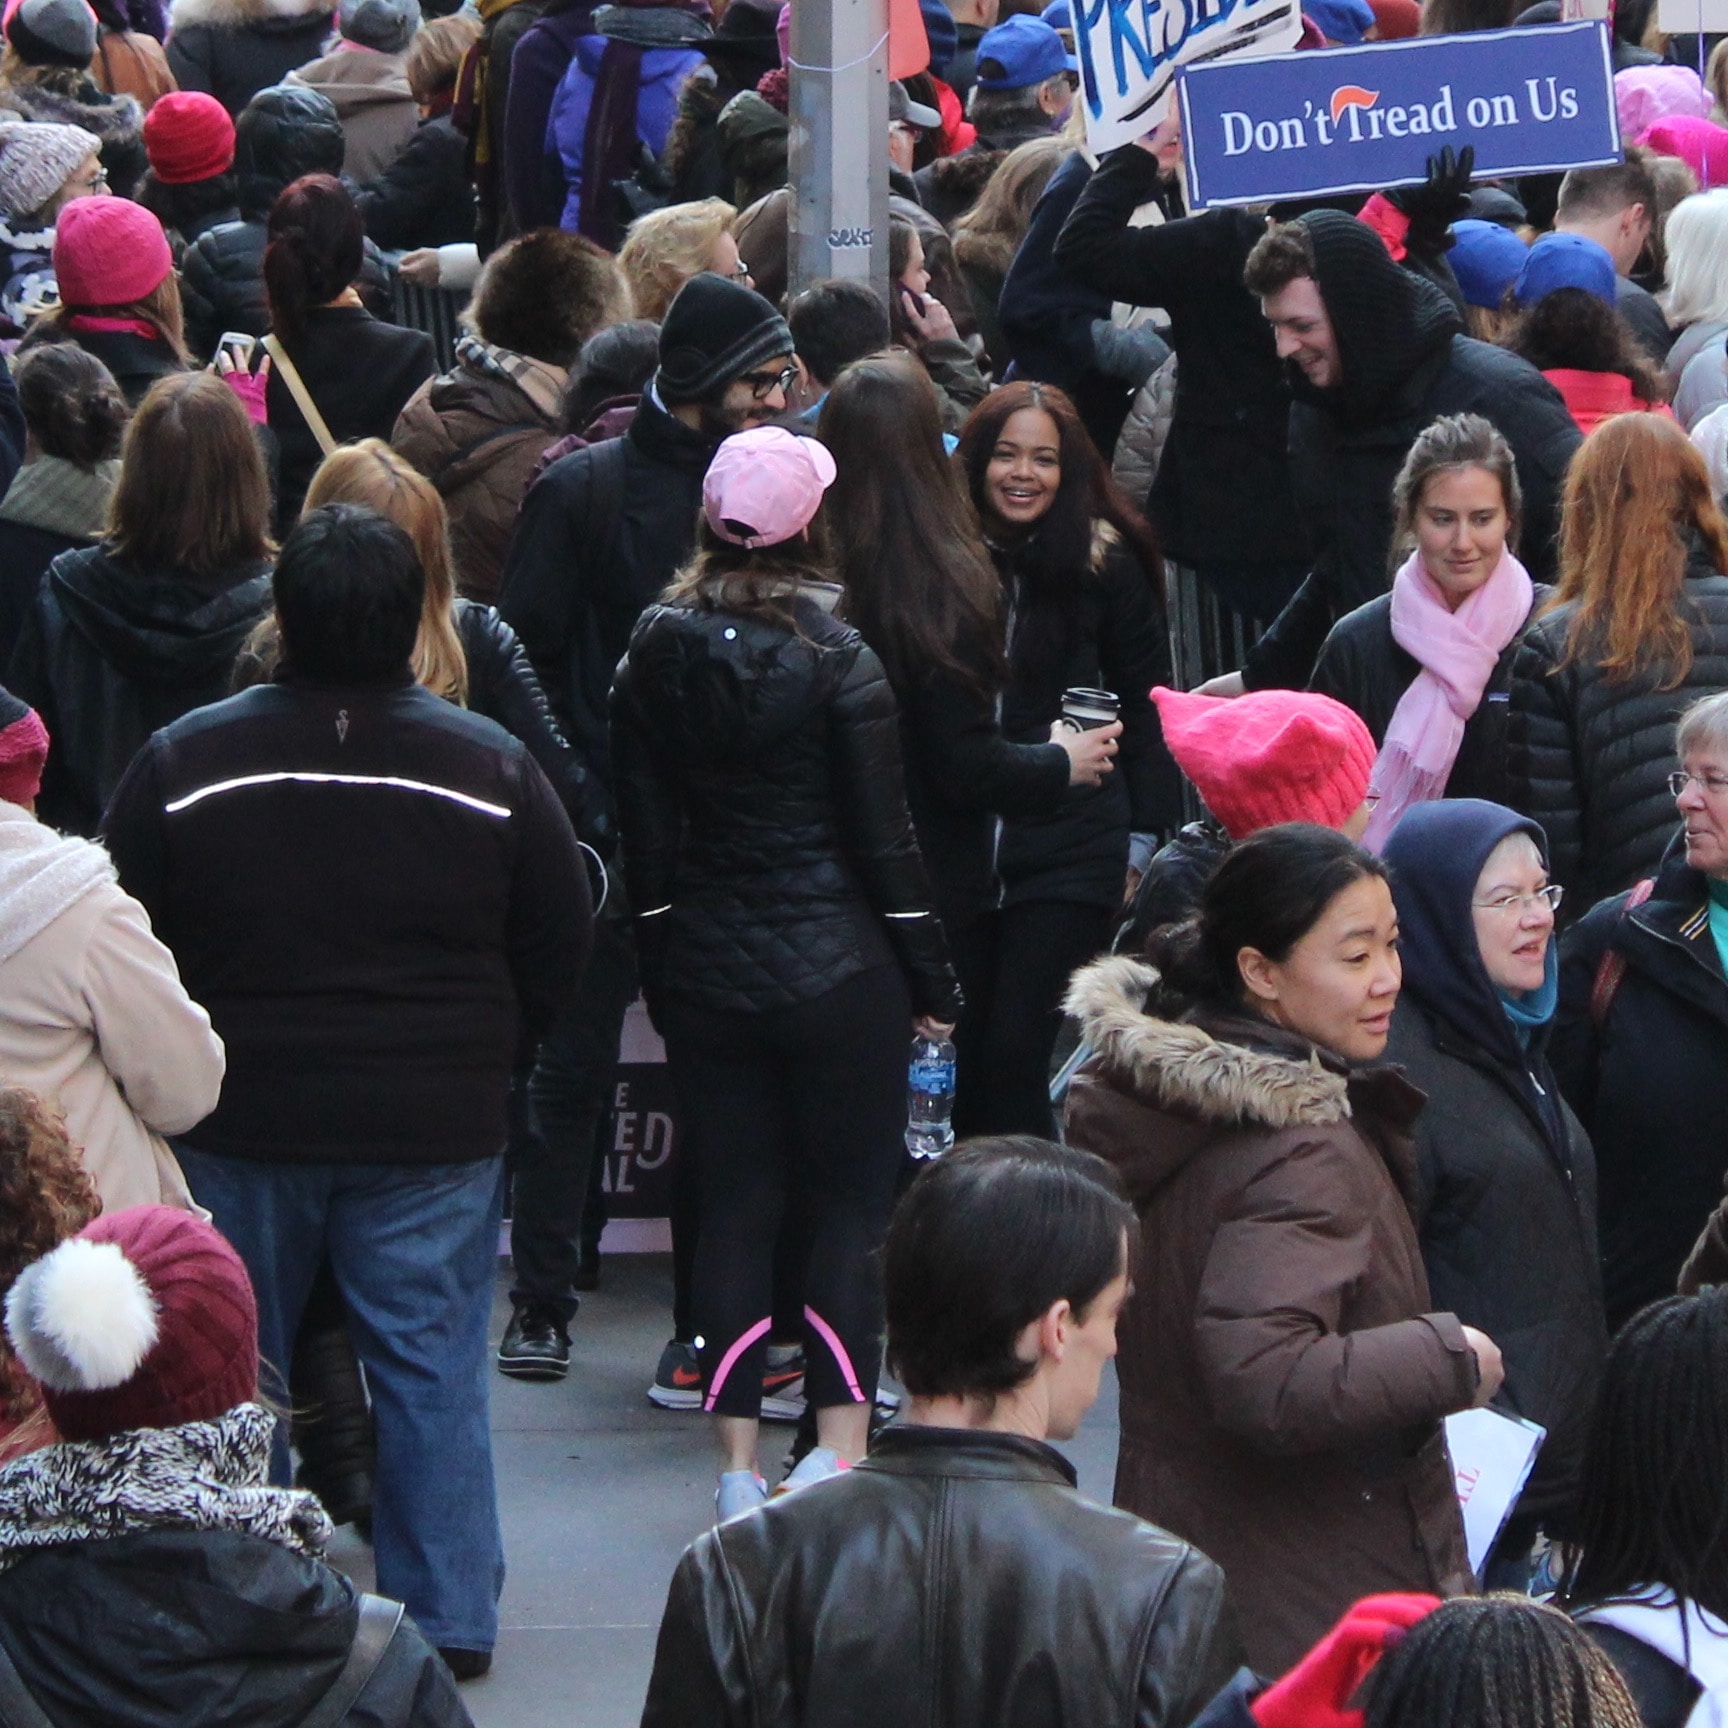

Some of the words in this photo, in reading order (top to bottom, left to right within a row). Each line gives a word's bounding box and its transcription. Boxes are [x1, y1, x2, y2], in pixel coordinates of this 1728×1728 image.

[1221, 98, 1335, 158] Don't
[1330, 84, 1458, 142] Tread
[1466, 94, 1518, 127] on
[1526, 75, 1580, 122] Us
